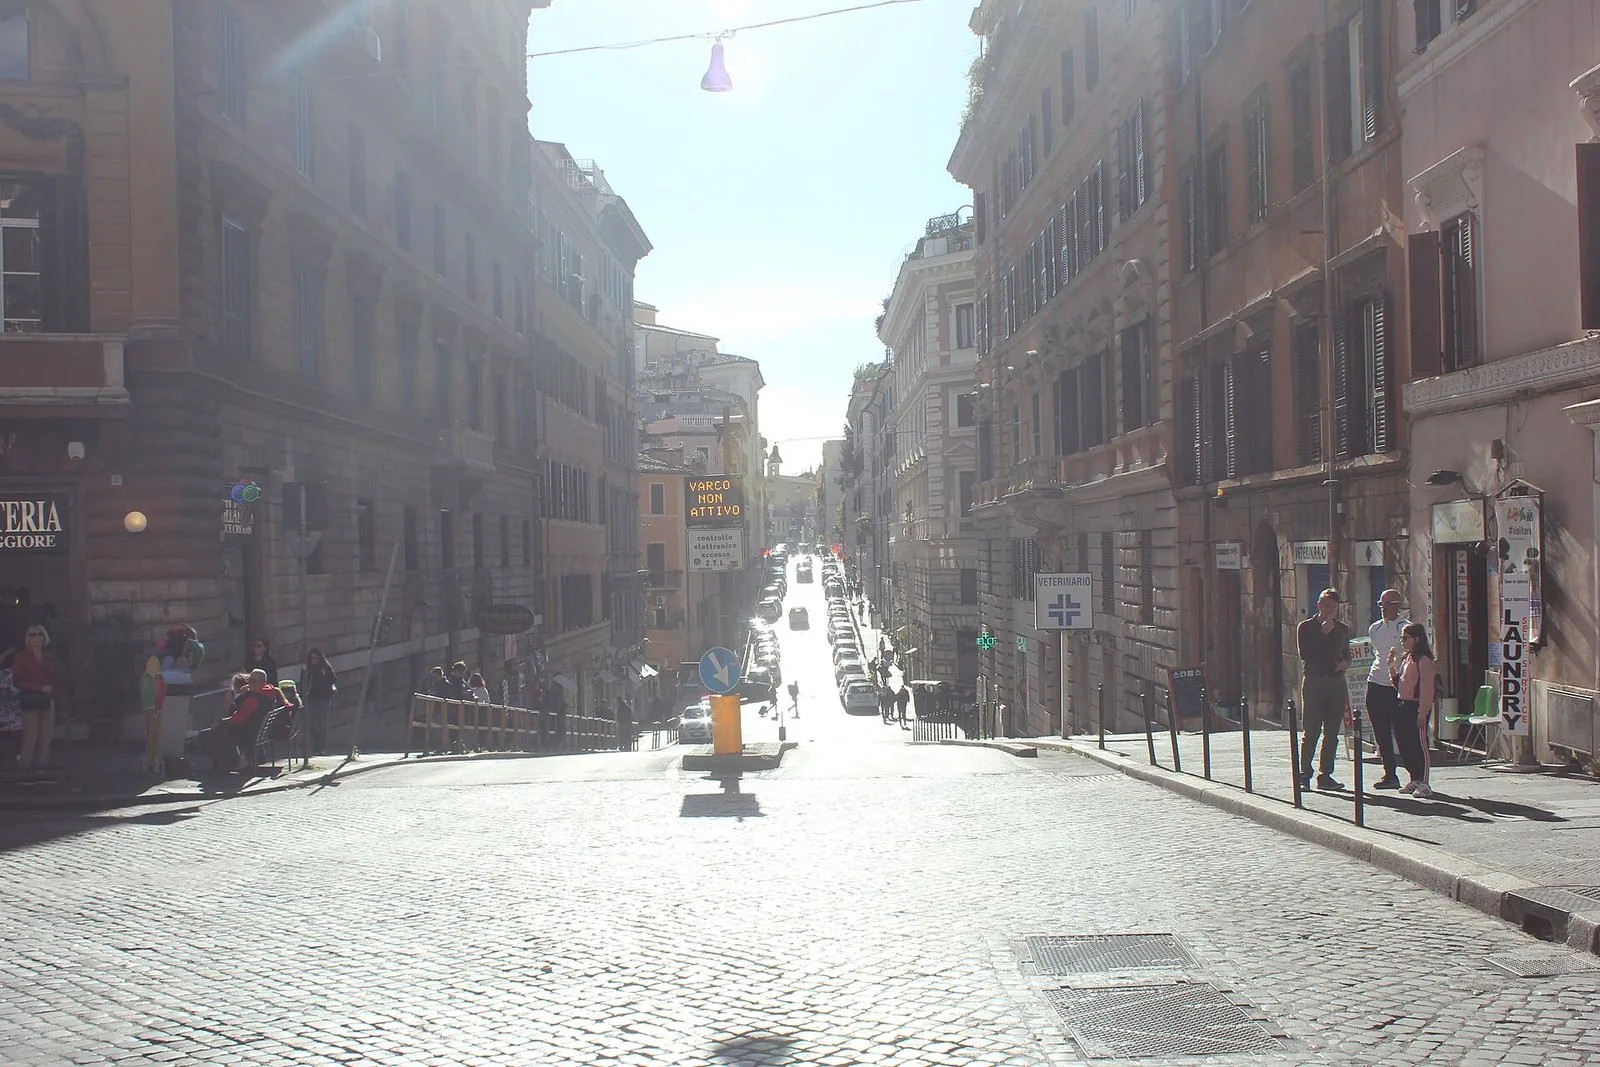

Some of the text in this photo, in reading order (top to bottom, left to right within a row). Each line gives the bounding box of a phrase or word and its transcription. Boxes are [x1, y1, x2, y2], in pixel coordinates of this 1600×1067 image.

[690, 480, 730, 491] VARCO
[698, 493, 723, 504] NON
[690, 505, 740, 517] ATTIVO
[696, 534, 733, 542] controllo
[693, 542, 737, 550] elettronico
[701, 551, 731, 559] accesso
[1037, 576, 1091, 587] VETERINARIO
[1502, 608, 1523, 731] LAUNDRY
